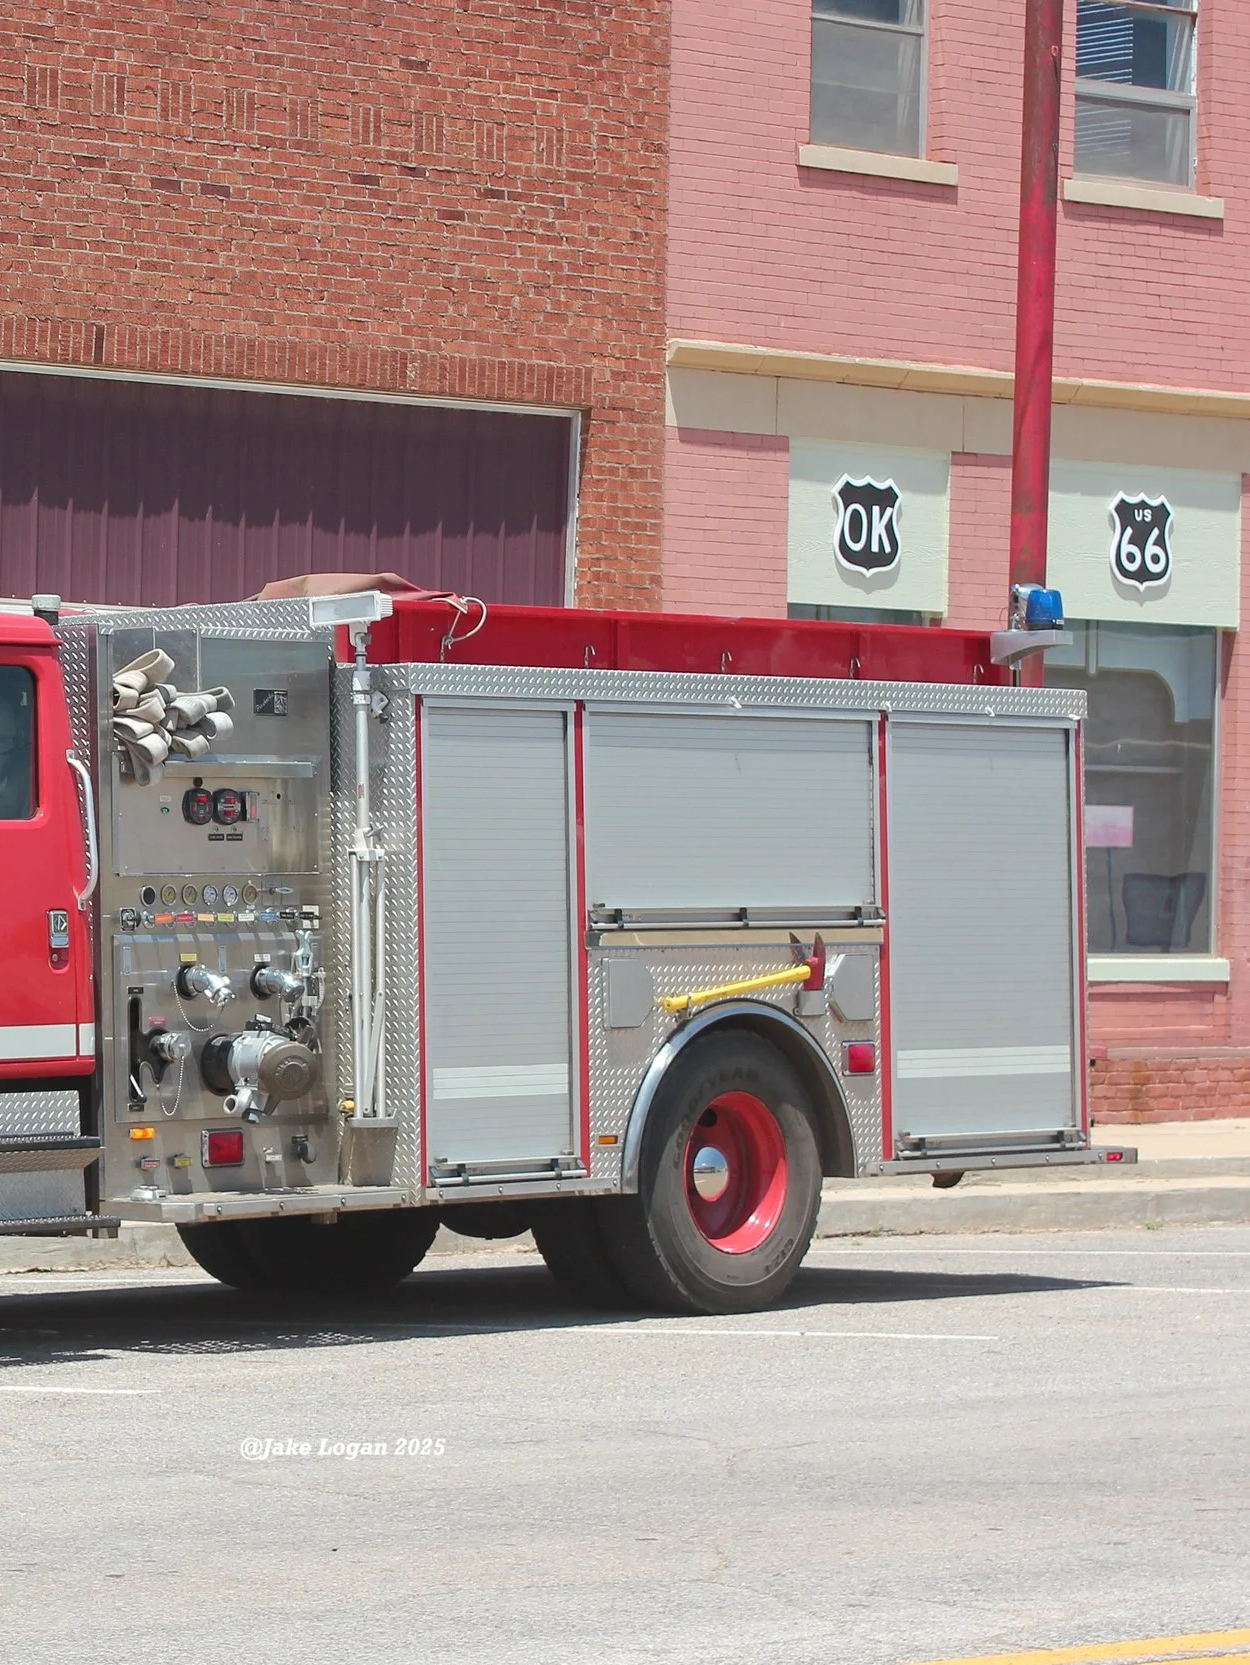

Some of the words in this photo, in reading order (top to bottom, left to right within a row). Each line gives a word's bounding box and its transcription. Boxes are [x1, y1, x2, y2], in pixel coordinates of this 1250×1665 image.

[843, 503, 893, 554] OK
[1134, 509, 1152, 522] US
[1120, 526, 1166, 573] 66
